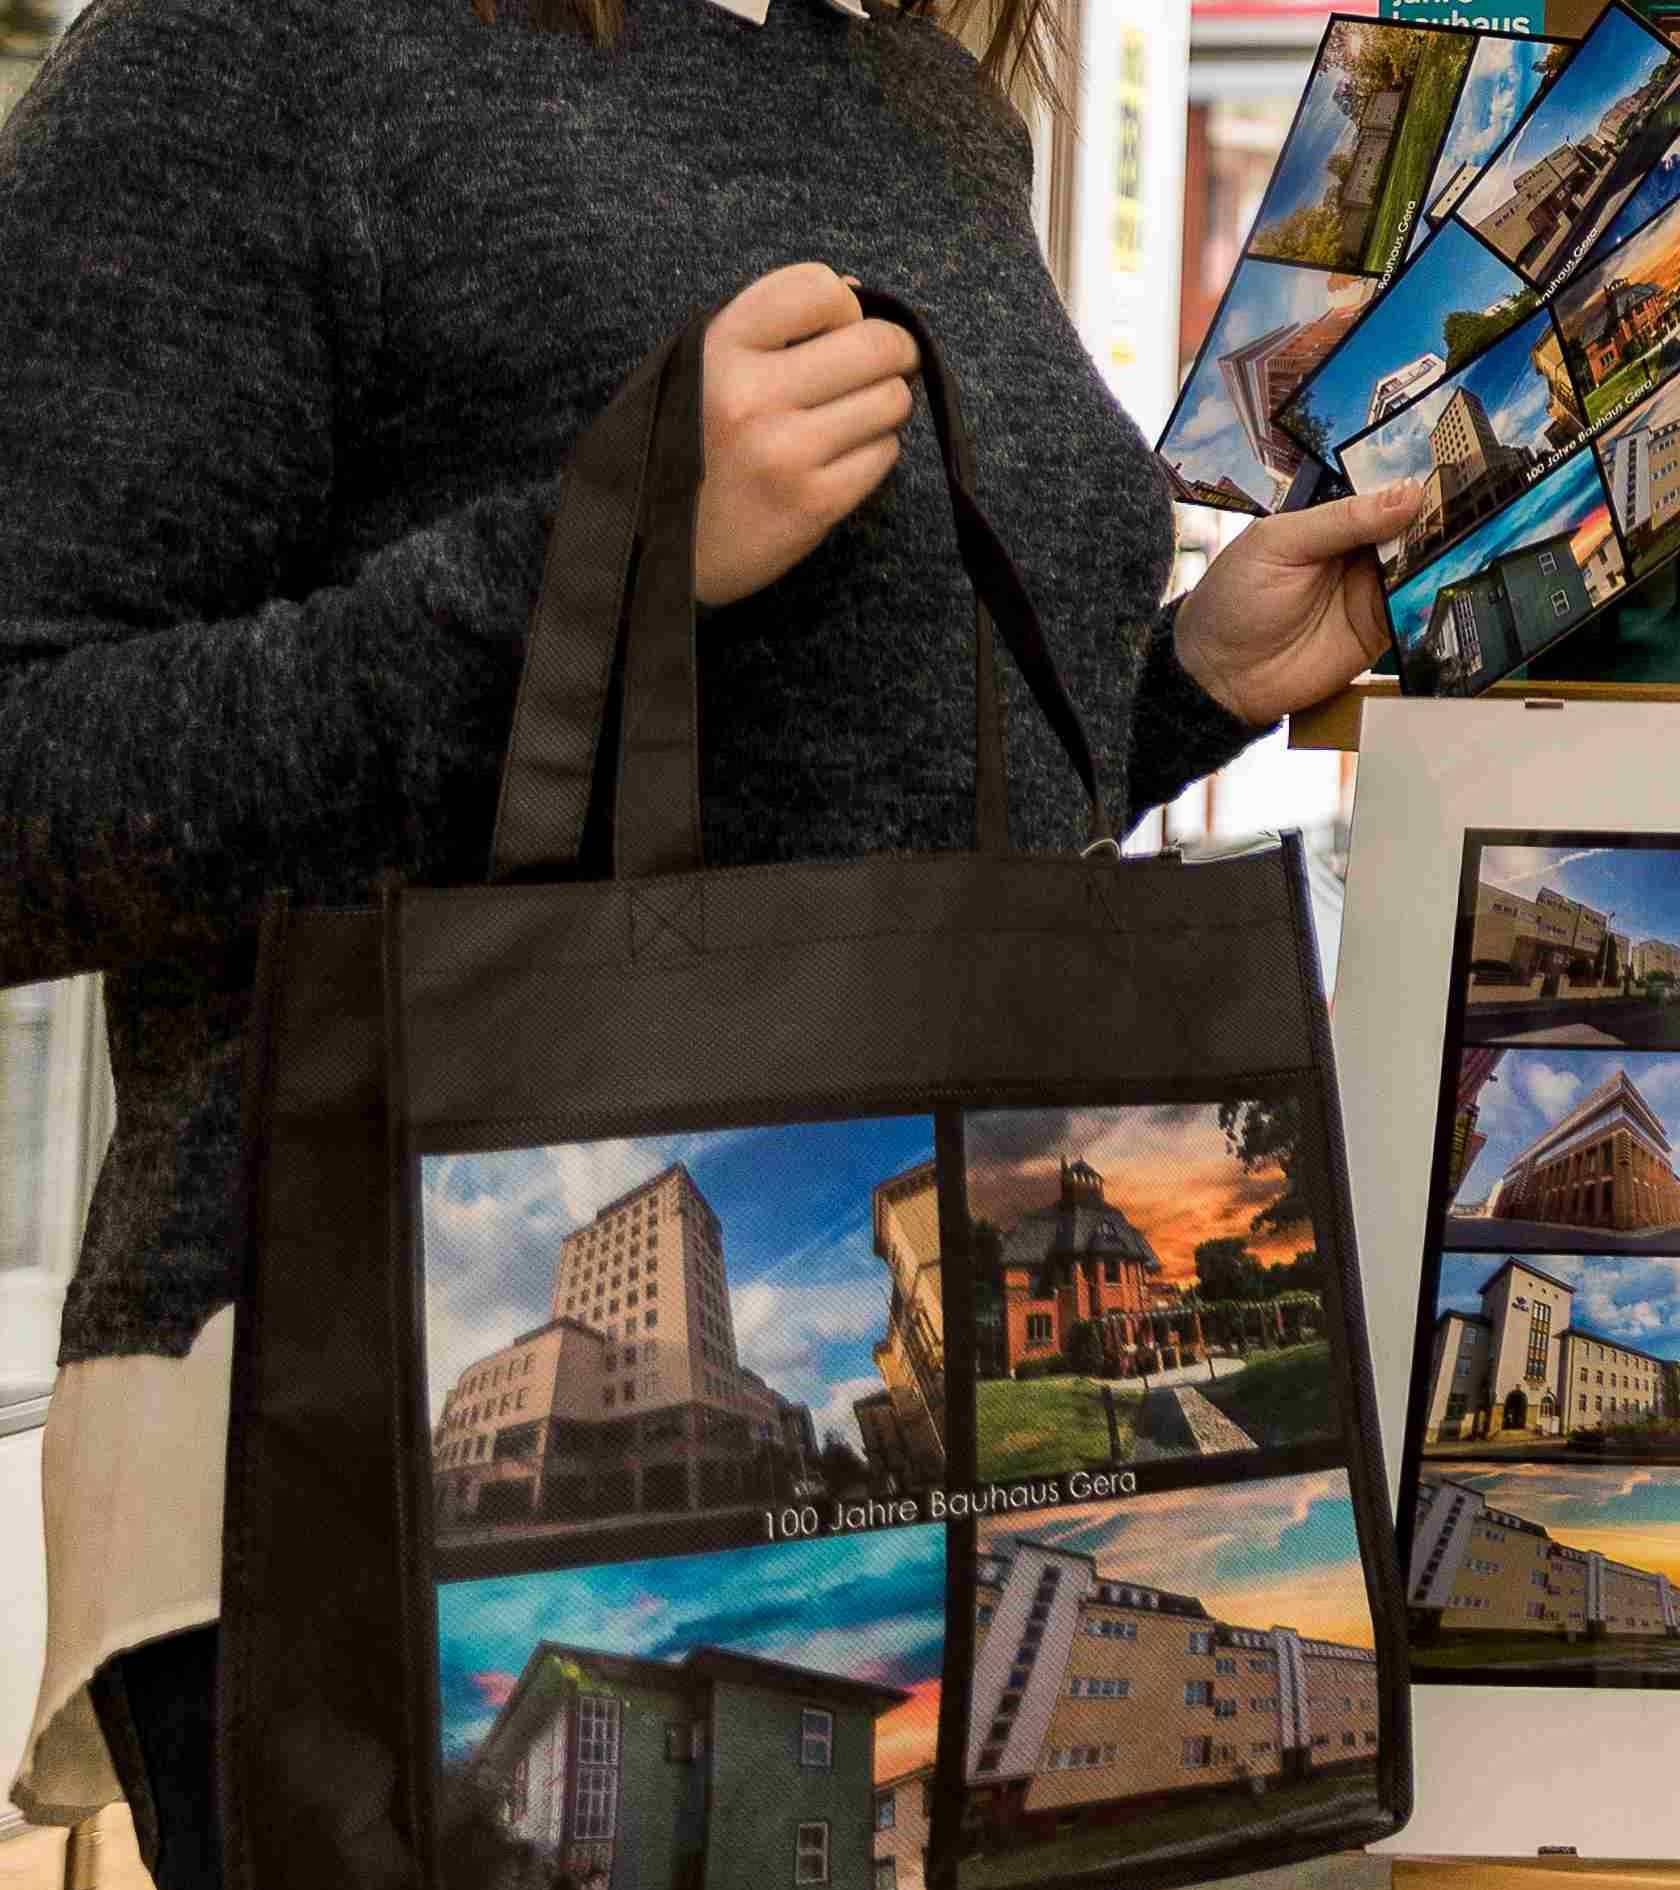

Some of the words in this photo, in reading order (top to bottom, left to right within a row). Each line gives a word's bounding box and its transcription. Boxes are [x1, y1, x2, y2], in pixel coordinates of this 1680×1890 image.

[1398, 200, 1417, 234] Gera
[1525, 464, 1546, 483] 100
[1547, 441, 1576, 469] Jahre
[1578, 405, 1625, 442] Bauhaus
[1624, 380, 1653, 406] Gera
[764, 1506, 818, 1541] 100
[830, 1496, 919, 1530] Jahre
[931, 1481, 1060, 1518] Bauhaus
[1069, 1470, 1137, 1500] Gera
